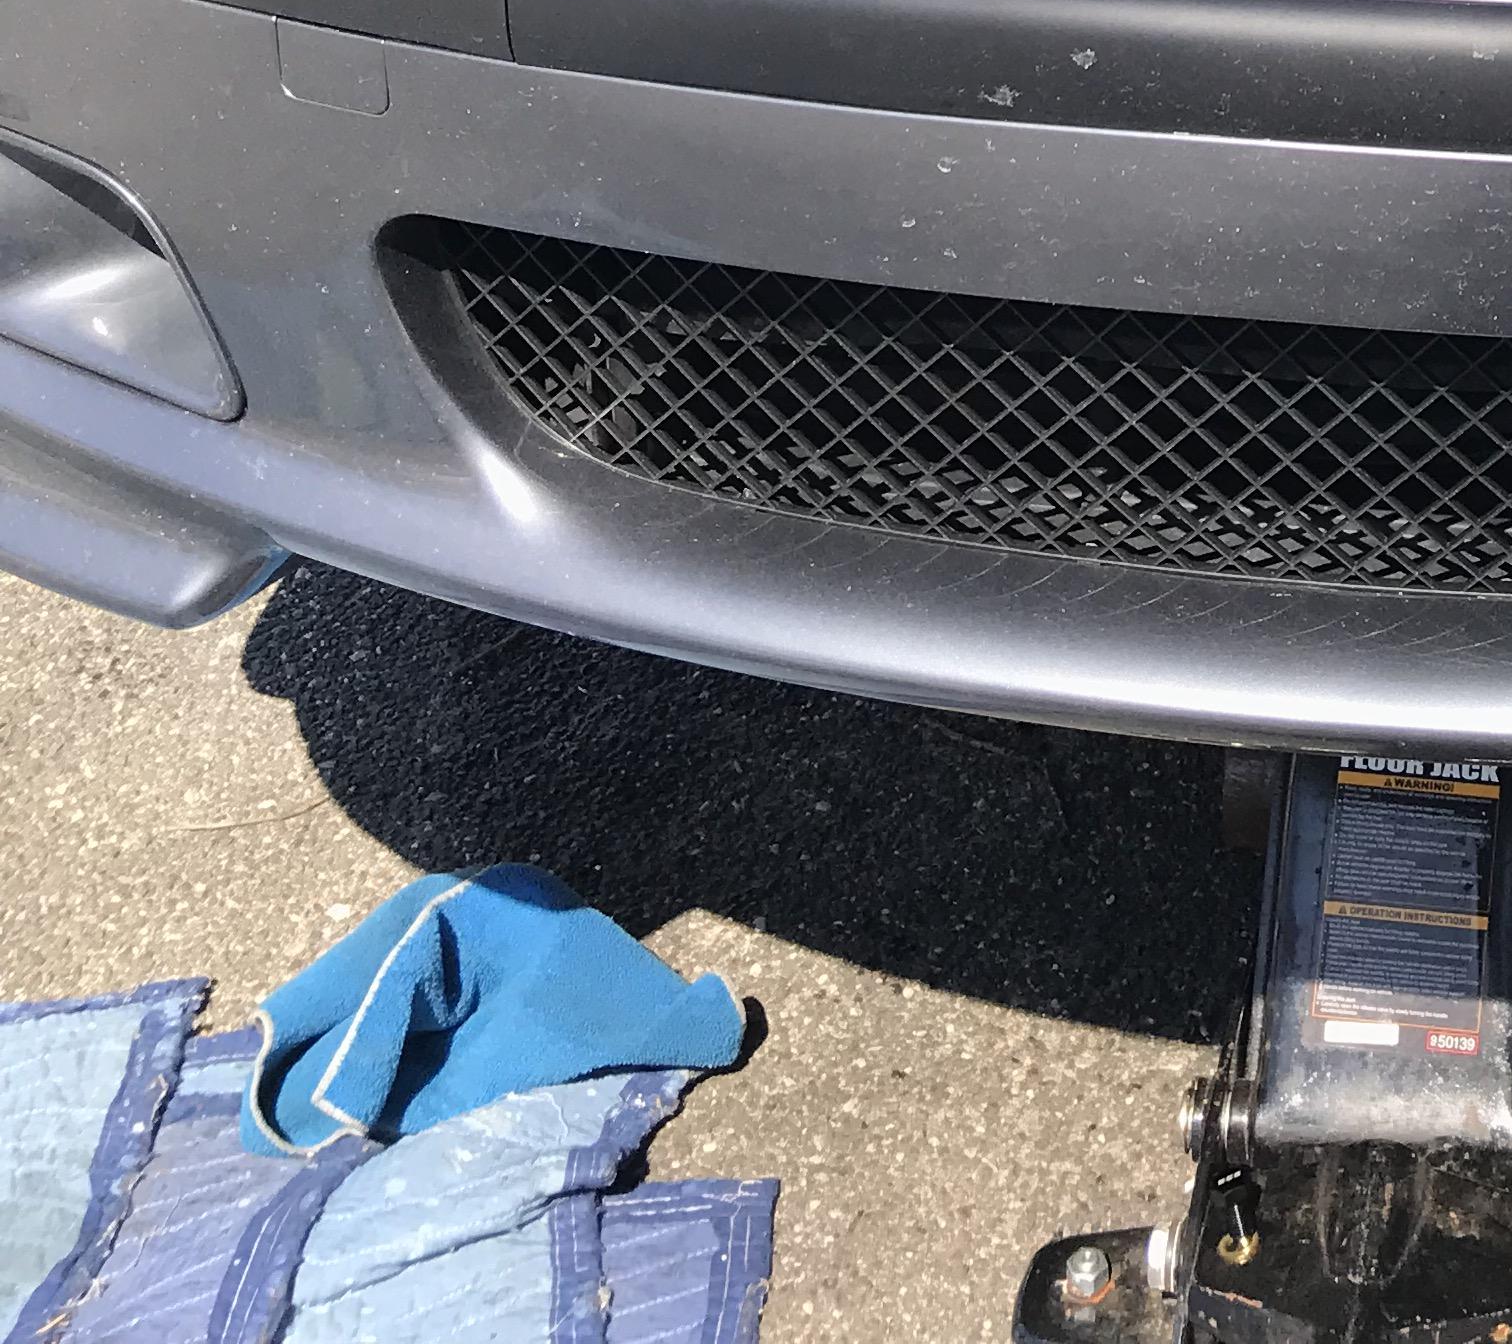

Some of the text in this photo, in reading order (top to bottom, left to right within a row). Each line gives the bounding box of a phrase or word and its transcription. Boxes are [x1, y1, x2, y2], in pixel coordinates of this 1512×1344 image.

[1430, 761, 1500, 783] JACK
[1394, 777, 1455, 793] WARNING!
[1350, 906, 1472, 927] OPERATION INSTRUCTIONS
